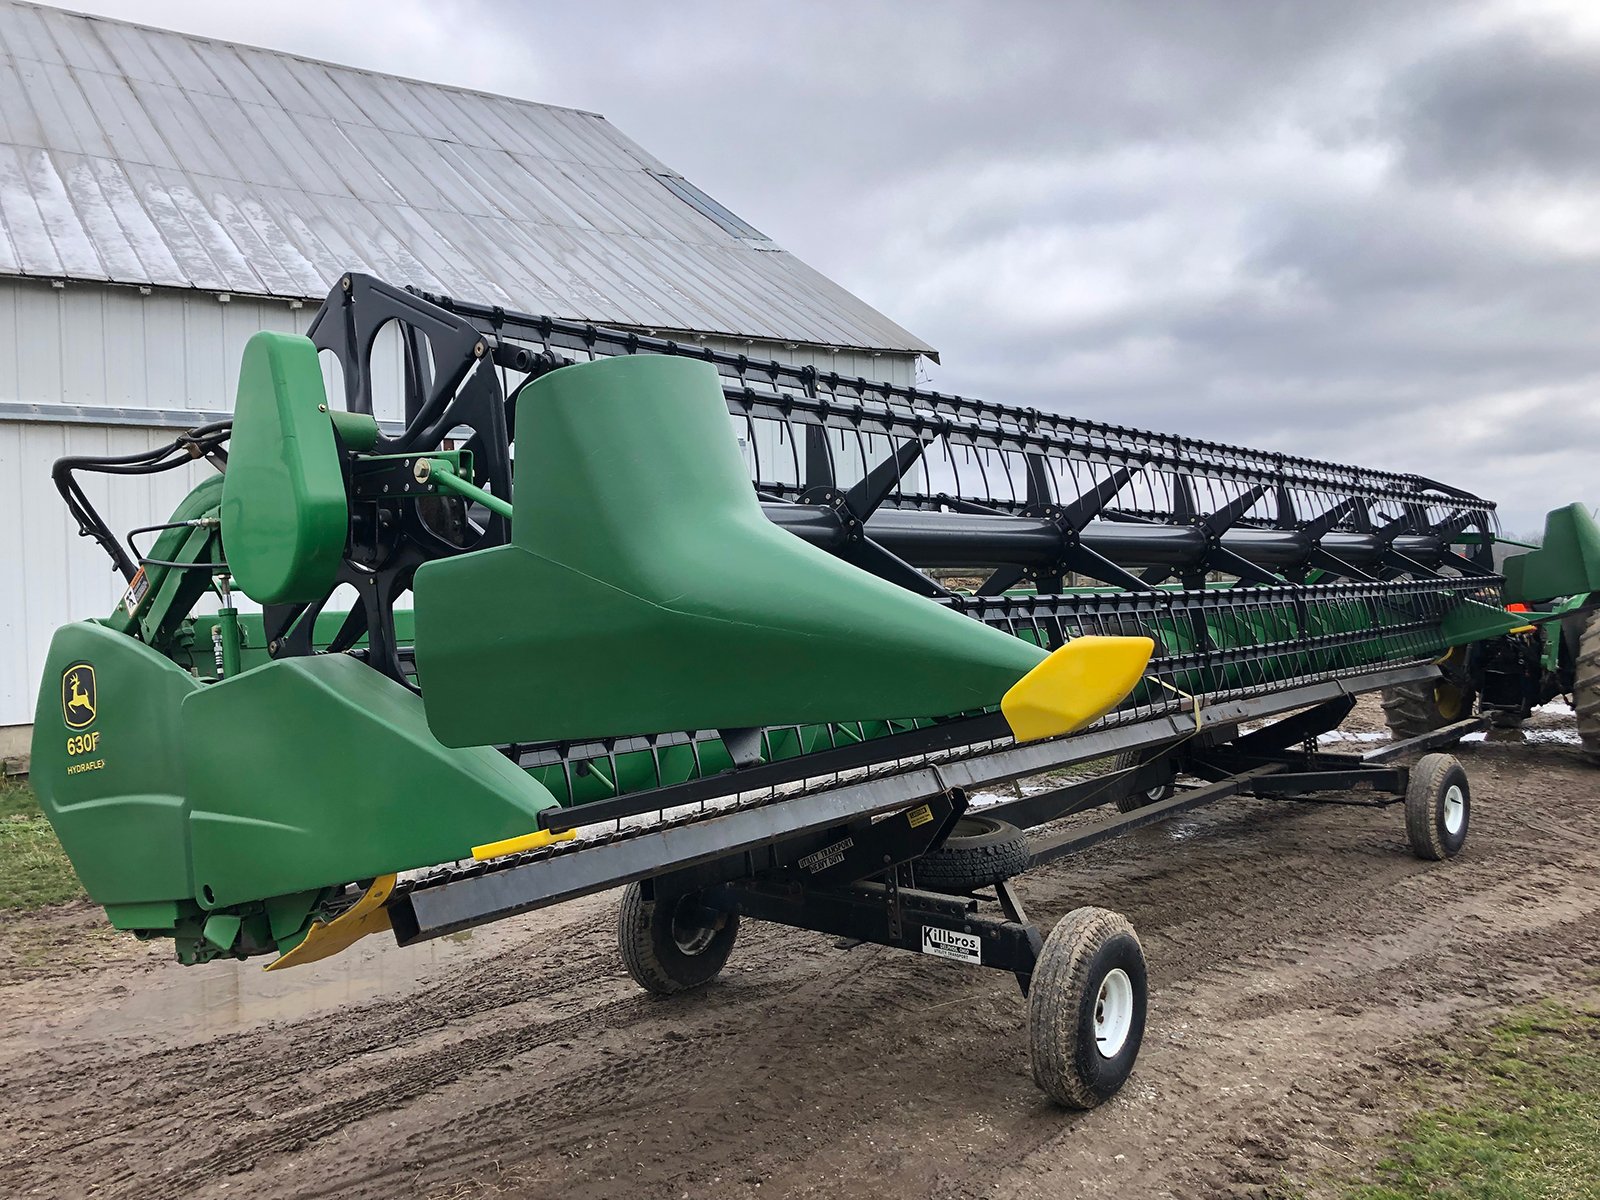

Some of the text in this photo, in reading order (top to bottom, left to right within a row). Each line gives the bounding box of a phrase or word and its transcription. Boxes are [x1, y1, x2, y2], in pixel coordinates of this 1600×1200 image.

[67, 732, 100, 755] 630F
[821, 839, 853, 858] TRANSPORT
[810, 852, 844, 872] HEAVY DUTY
[924, 927, 975, 948] Killbros
